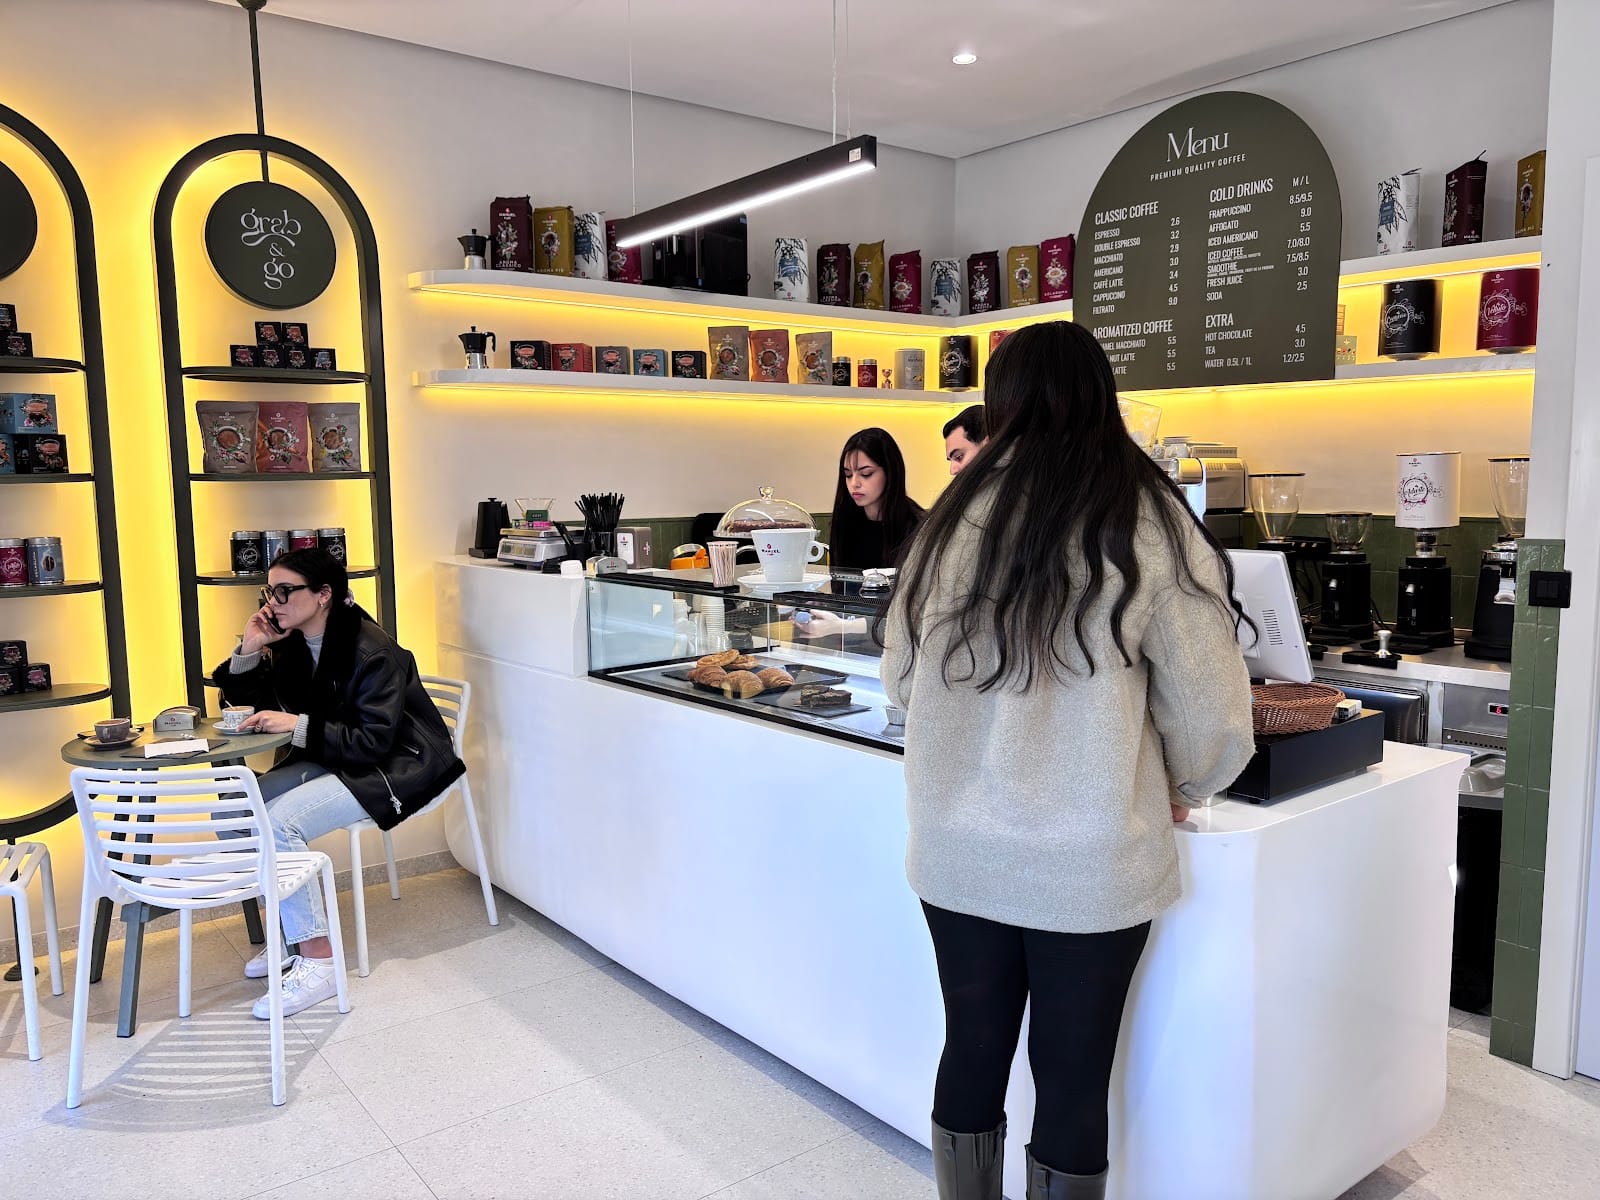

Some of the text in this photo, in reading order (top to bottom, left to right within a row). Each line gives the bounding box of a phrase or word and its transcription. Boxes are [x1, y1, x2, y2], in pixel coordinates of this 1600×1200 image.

[1166, 127, 1229, 162] Menu
[1150, 154, 1246, 182] PREMIUM QUALITY COFFEE
[1210, 186, 1234, 202] COLD
[1237, 178, 1273, 198] DRINKS
[1292, 178, 1299, 187] M
[1306, 176, 1310, 185] L
[1095, 201, 1159, 225] CLASSIC COFFEE
[1209, 192, 1313, 219] FRAPPUCCINO 8.5/9.5
[240, 208, 301, 247] grab
[1095, 217, 1180, 240] ESPRESSO 2.6
[1209, 207, 1312, 233] AFFOGATO 9.0
[1094, 230, 1180, 253] DOUBLE ESPRESSO 3.2
[1208, 222, 1311, 247] ICED AMERICANO 5.5
[270, 242, 285, 257] &
[1208, 251, 1220, 260] ICED
[1222, 247, 1244, 258] COFFEE
[1287, 237, 1310, 248] 7.0/8.0
[1094, 253, 1123, 265] MACCHIATO
[1094, 257, 1179, 277] AMERICANO 3.0
[1208, 262, 1238, 274] SMOOTHIE
[1286, 251, 1309, 263] 7.5/8.5
[264, 258, 294, 289] go
[1109, 278, 1123, 288] LATTE
[1169, 270, 1178, 280] 3.4
[1207, 266, 1308, 288] FRESH JUICE 3.0
[1093, 283, 1178, 302] CAPPUCCINO 4.5
[1207, 281, 1308, 301] SODA 2.5
[1093, 297, 1178, 315] FILTRATO 9.0
[1093, 319, 1173, 339] AROMATIZED COFFEE
[1205, 313, 1234, 328] EXTRA
[1205, 323, 1306, 342] HOT CHOCOLATE 4.5
[1116, 339, 1146, 350] MACCHIATO
[1168, 336, 1177, 345] 5.5
[1205, 338, 1305, 355] TEA 3.0
[1121, 353, 1136, 362] LATTE
[1167, 349, 1176, 358] 5.5
[1205, 359, 1224, 368] WATER
[1226, 357, 1239, 367] 0.5L
[1245, 356, 1252, 366] 1L
[1283, 353, 1305, 363] 1.2/2.5
[1166, 362, 1176, 371] 5.5
